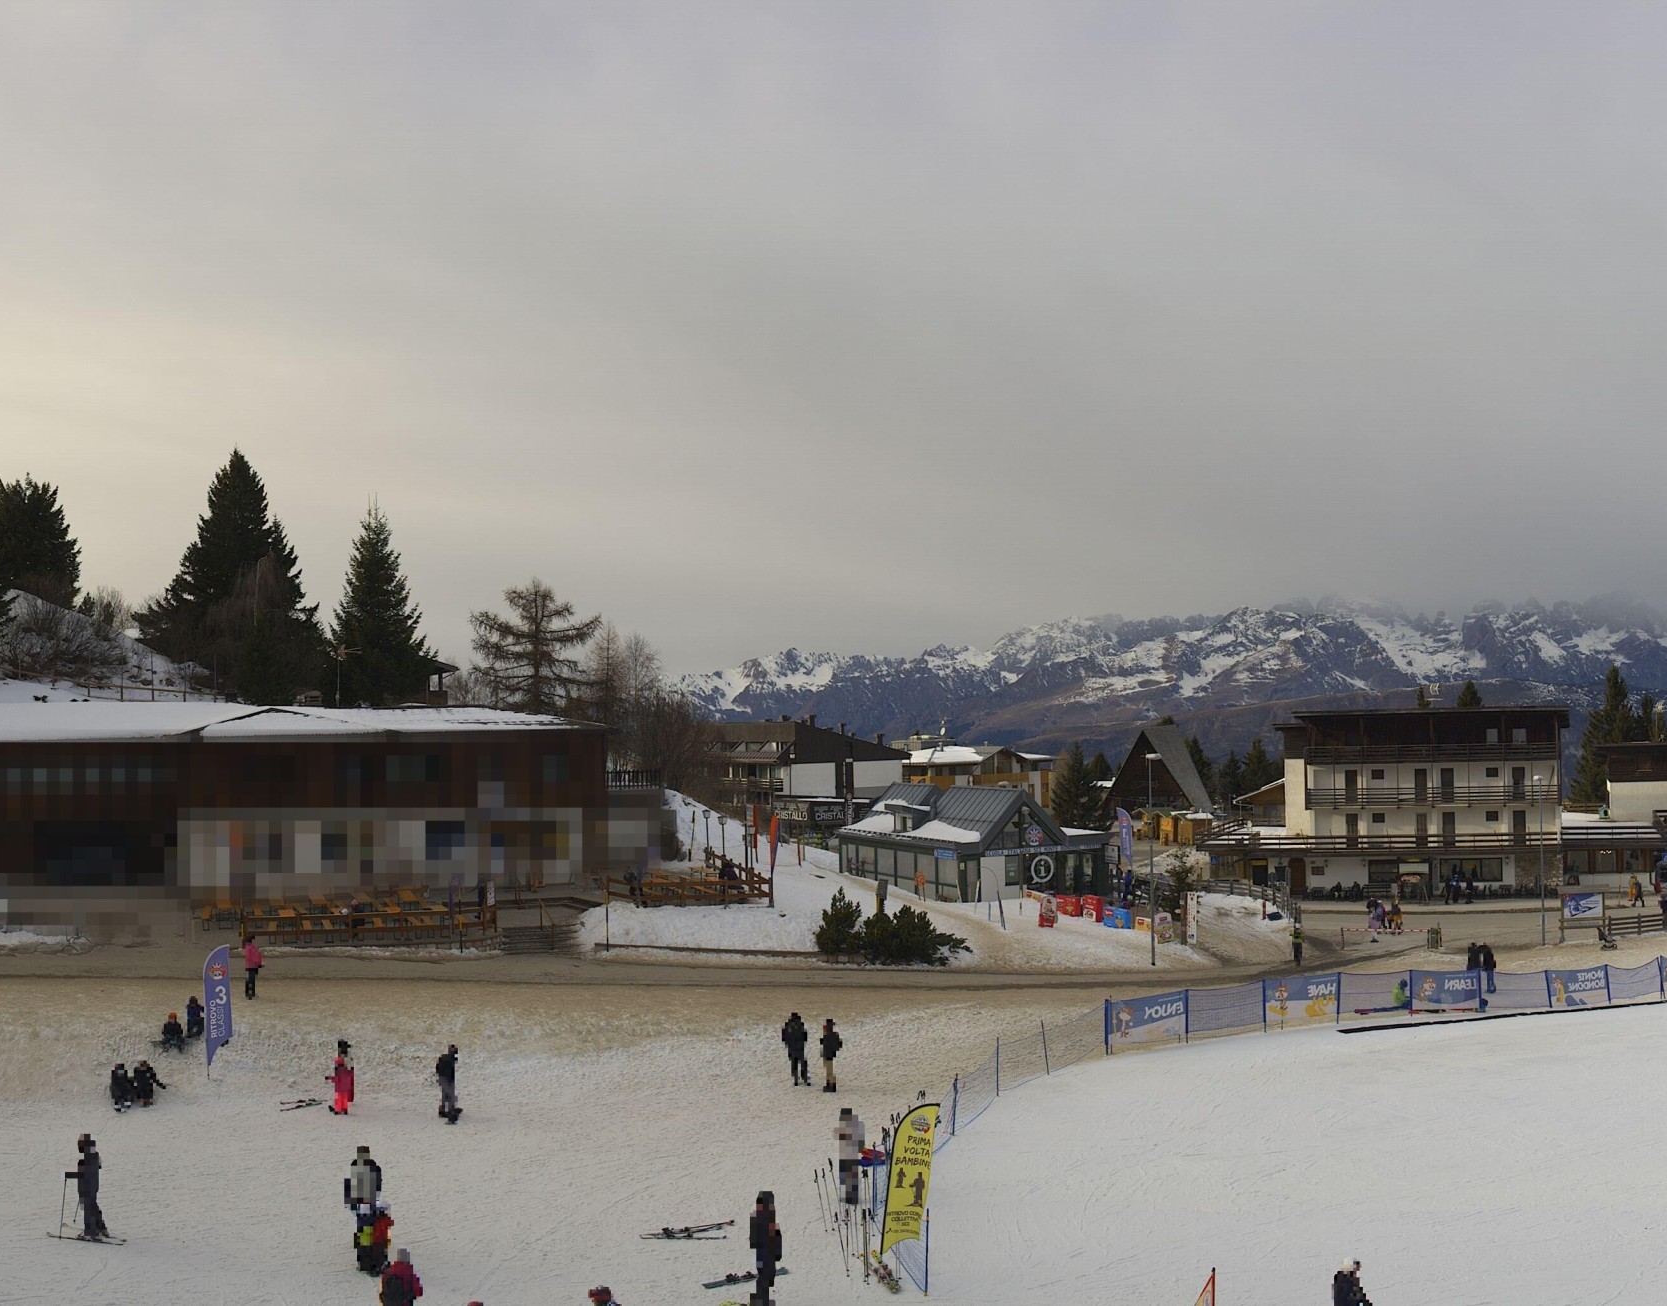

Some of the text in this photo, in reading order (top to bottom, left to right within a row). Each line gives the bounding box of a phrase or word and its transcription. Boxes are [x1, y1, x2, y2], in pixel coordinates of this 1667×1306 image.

[215, 985, 227, 1005] 3
[209, 1000, 218, 1038] RITROVO
[217, 1006, 226, 1037] CLASSI
[907, 1135, 931, 1148] PRIMA
[904, 1146, 930, 1159] VOLTA
